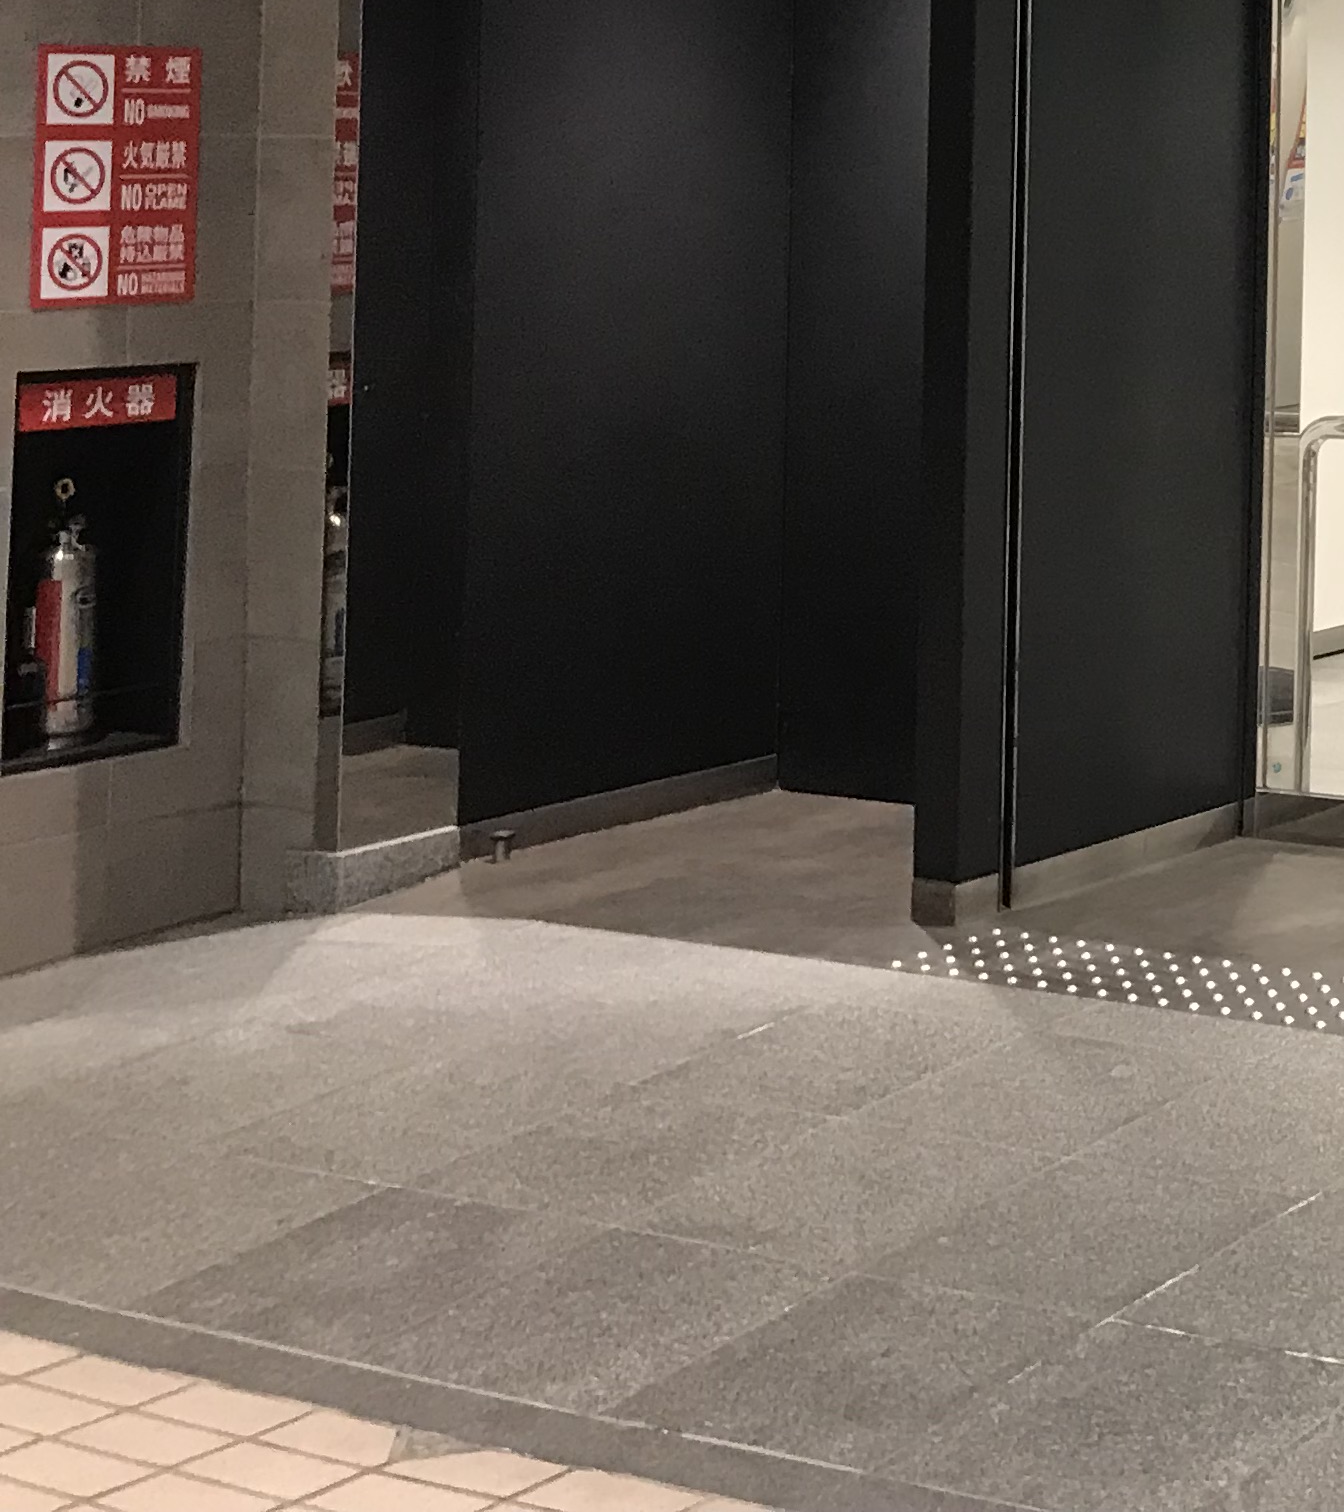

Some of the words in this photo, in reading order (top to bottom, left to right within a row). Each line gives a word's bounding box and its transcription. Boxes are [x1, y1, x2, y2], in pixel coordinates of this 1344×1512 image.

[124, 98, 145, 125] NO
[120, 184, 142, 211] NO
[117, 272, 139, 296] NO
[42, 383, 155, 423] 消火器
